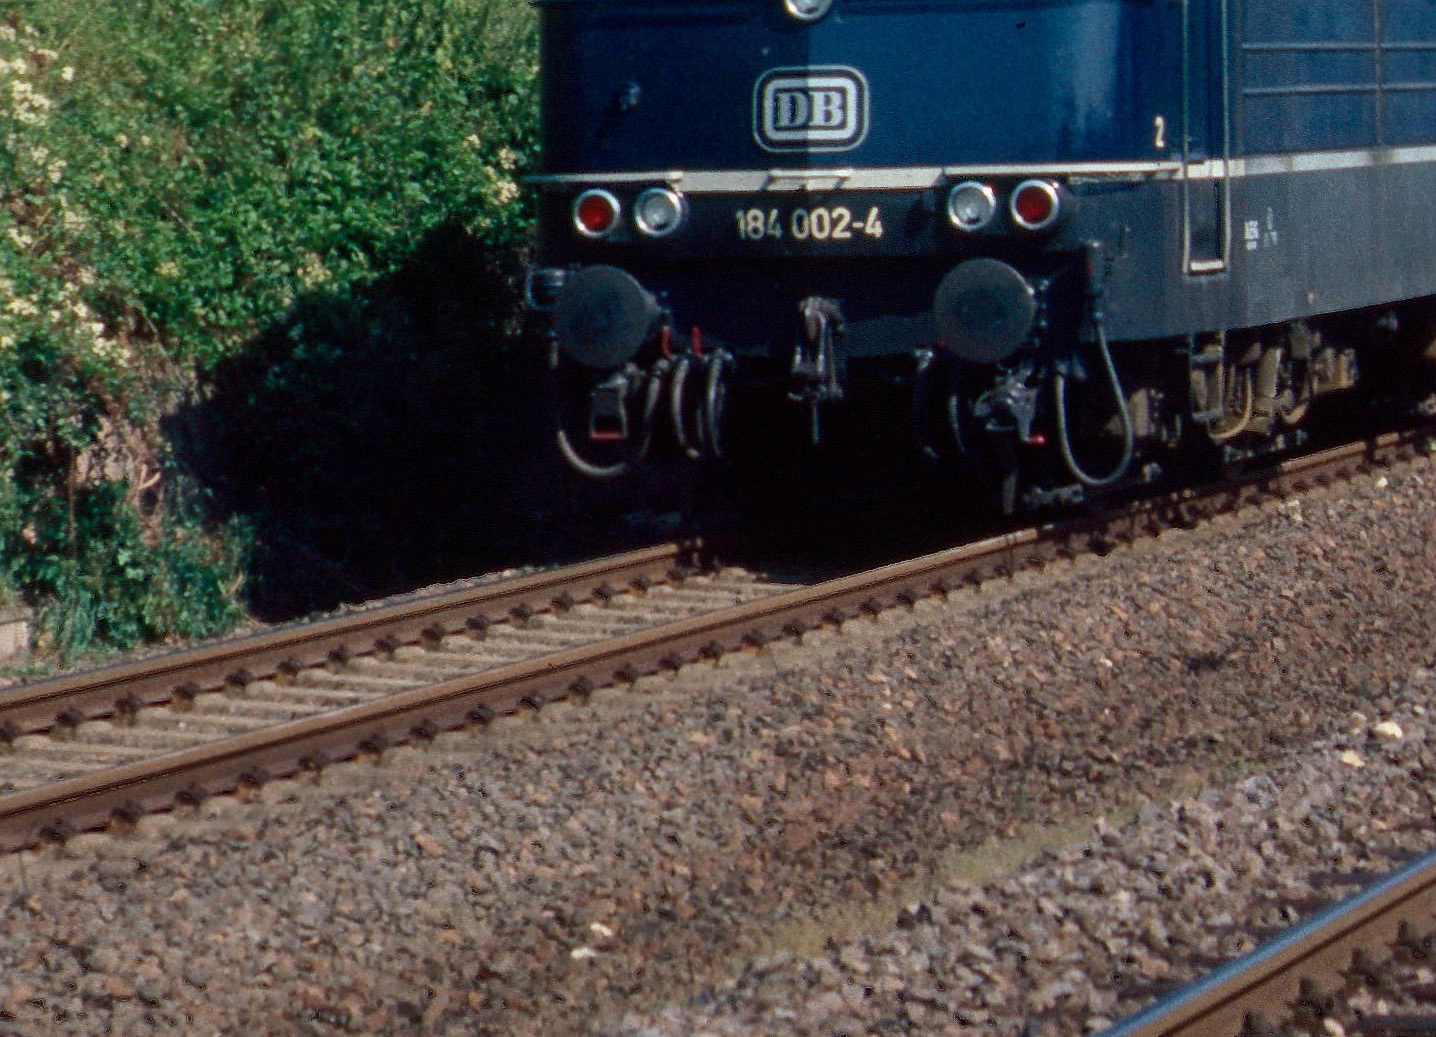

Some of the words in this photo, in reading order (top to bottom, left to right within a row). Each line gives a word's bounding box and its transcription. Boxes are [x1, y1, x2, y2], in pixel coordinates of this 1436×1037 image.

[775, 90, 844, 128] DB
[735, 208, 783, 240] 184
[791, 206, 884, 240] 002-4
